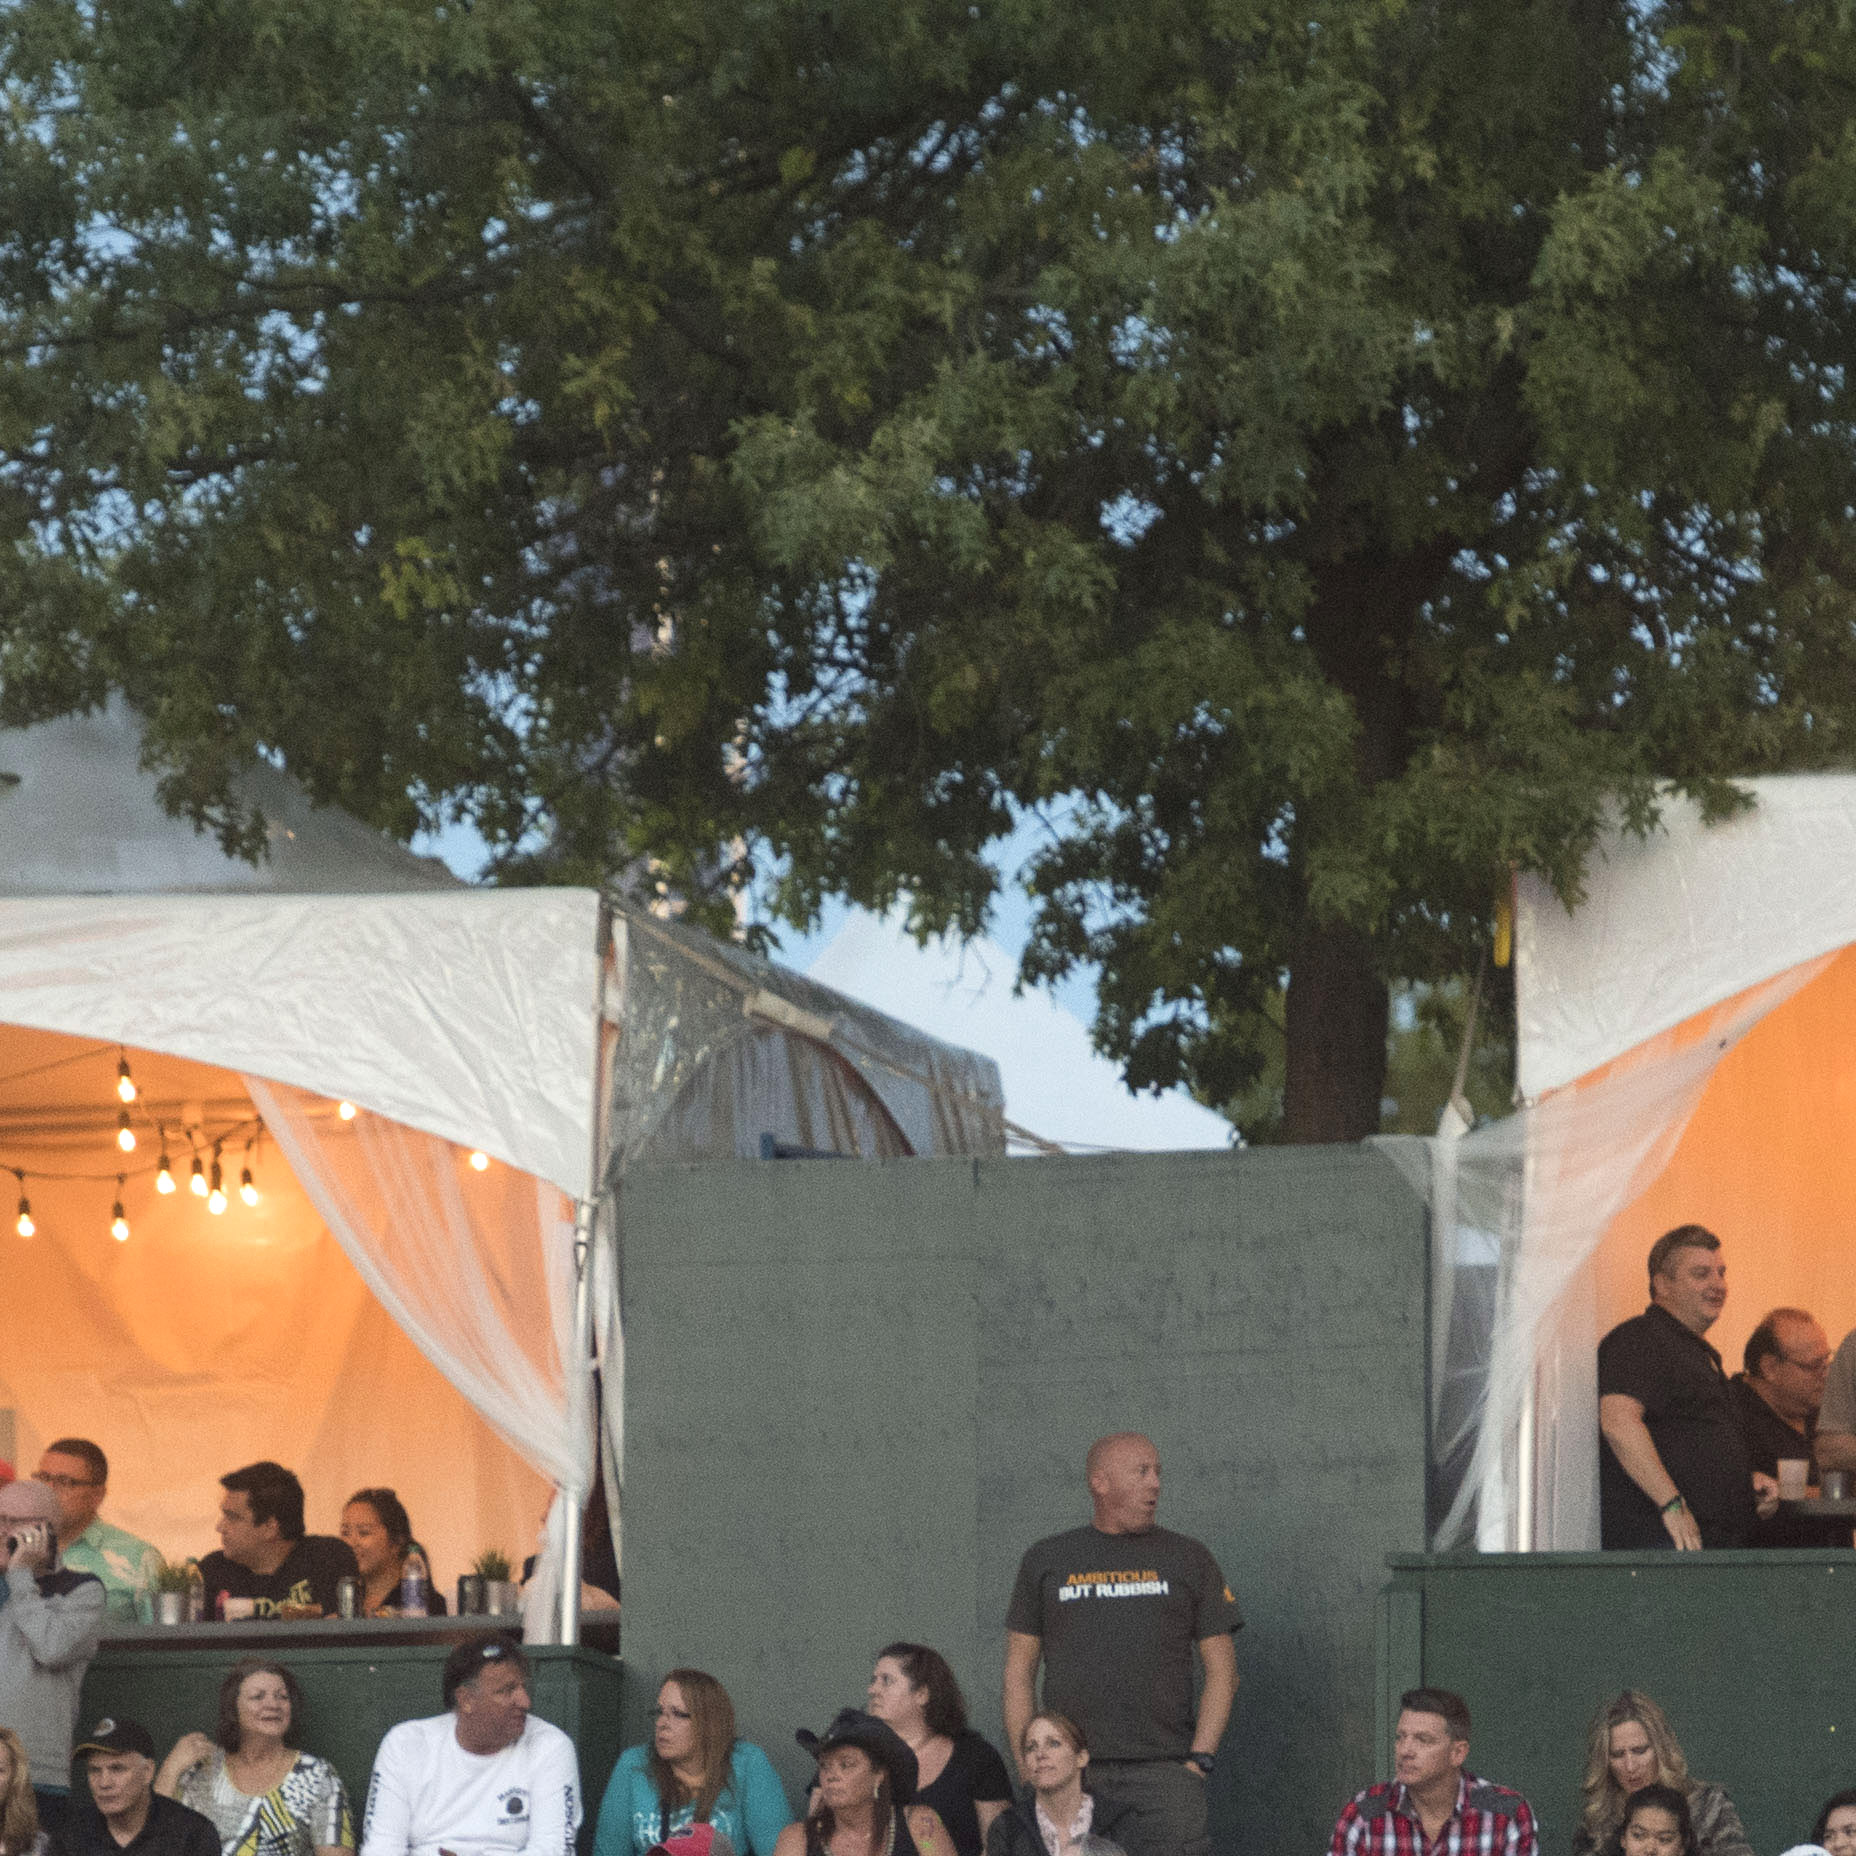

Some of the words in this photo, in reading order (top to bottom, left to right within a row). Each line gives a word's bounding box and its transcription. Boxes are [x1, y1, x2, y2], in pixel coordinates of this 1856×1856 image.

[1067, 1570, 1158, 1585] AMBITIOUS
[1059, 1585, 1093, 1602] BUT
[1095, 1581, 1169, 1598] RUBBISH
